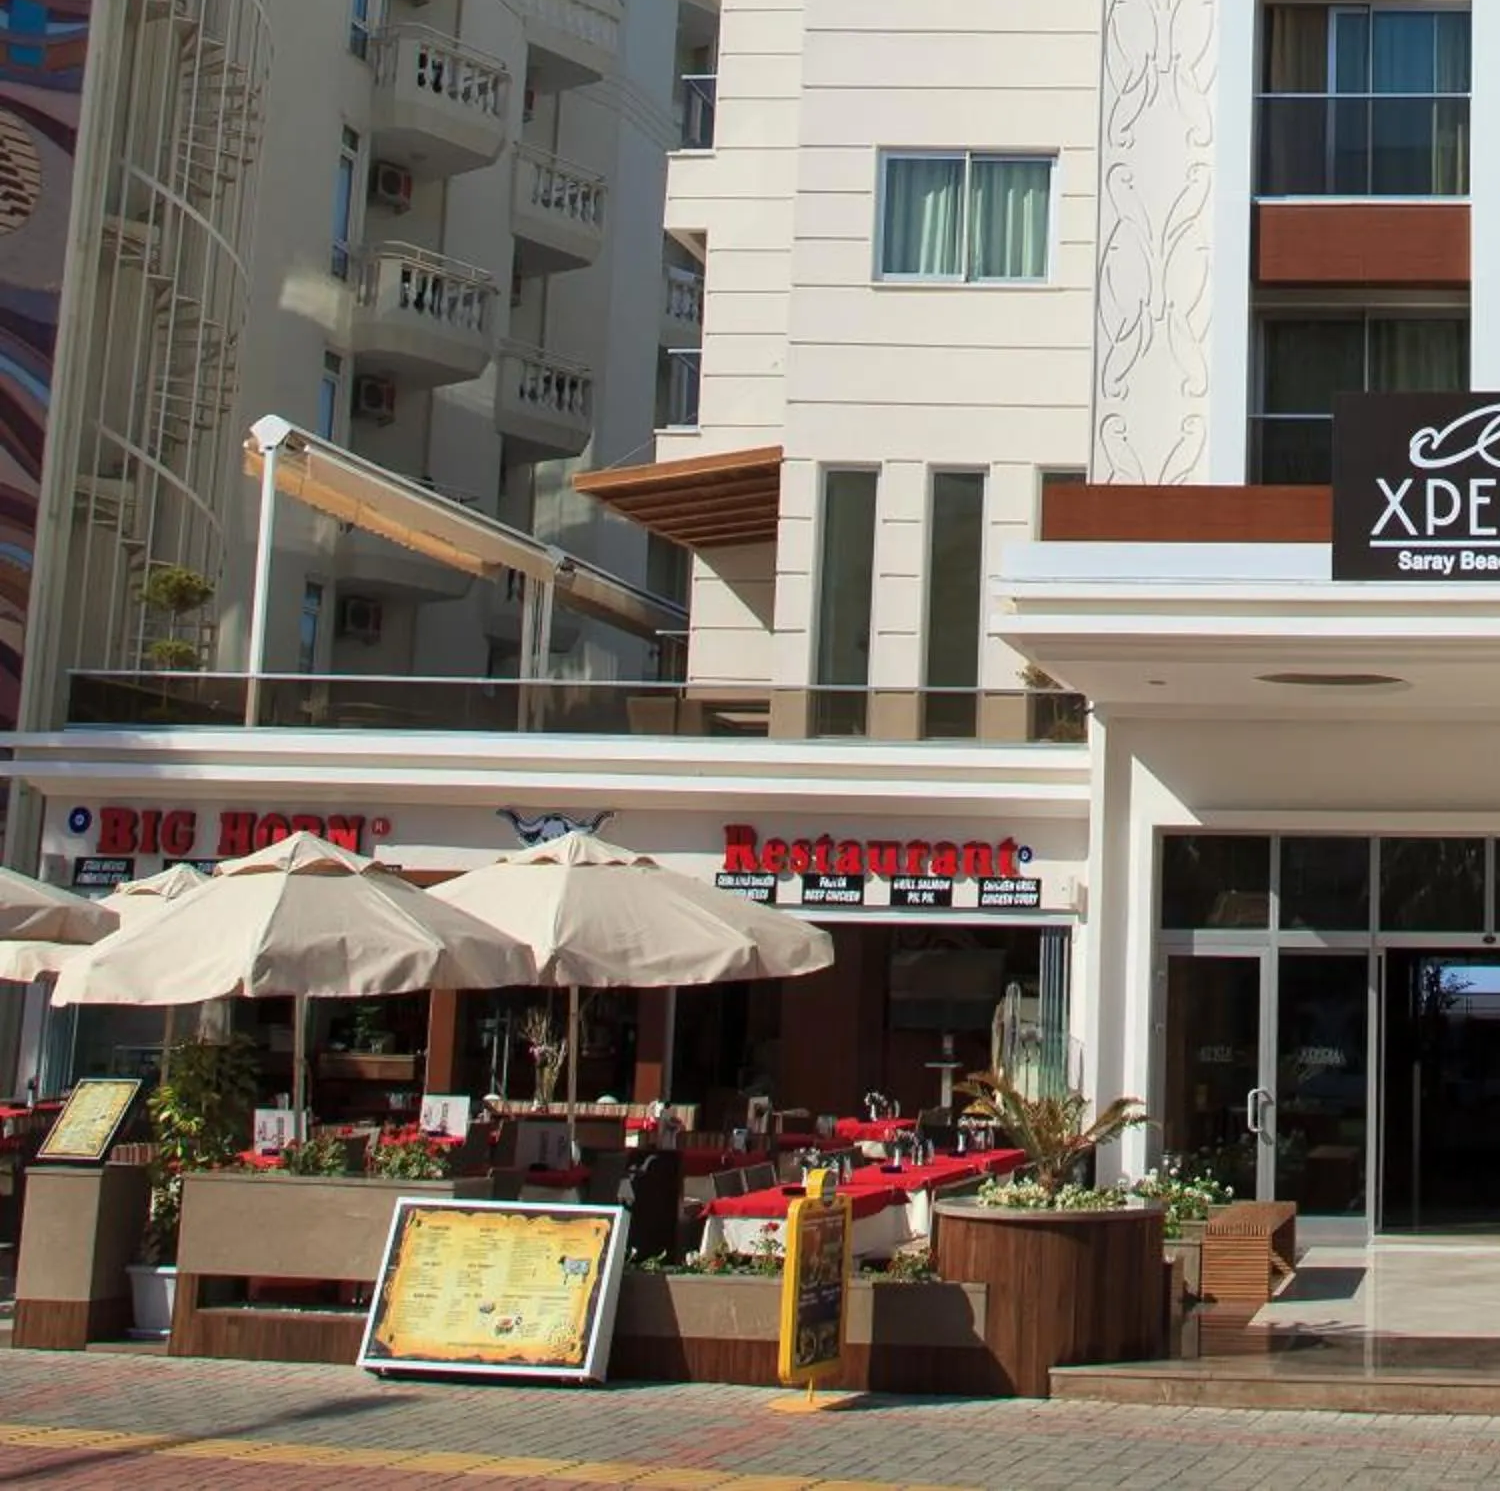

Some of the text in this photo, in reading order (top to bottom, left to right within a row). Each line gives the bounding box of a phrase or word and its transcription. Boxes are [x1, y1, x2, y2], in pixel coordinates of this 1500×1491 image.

[1398, 550, 1455, 575] Saray
[96, 807, 196, 855] BIG
[722, 823, 1018, 878] Restaurant
